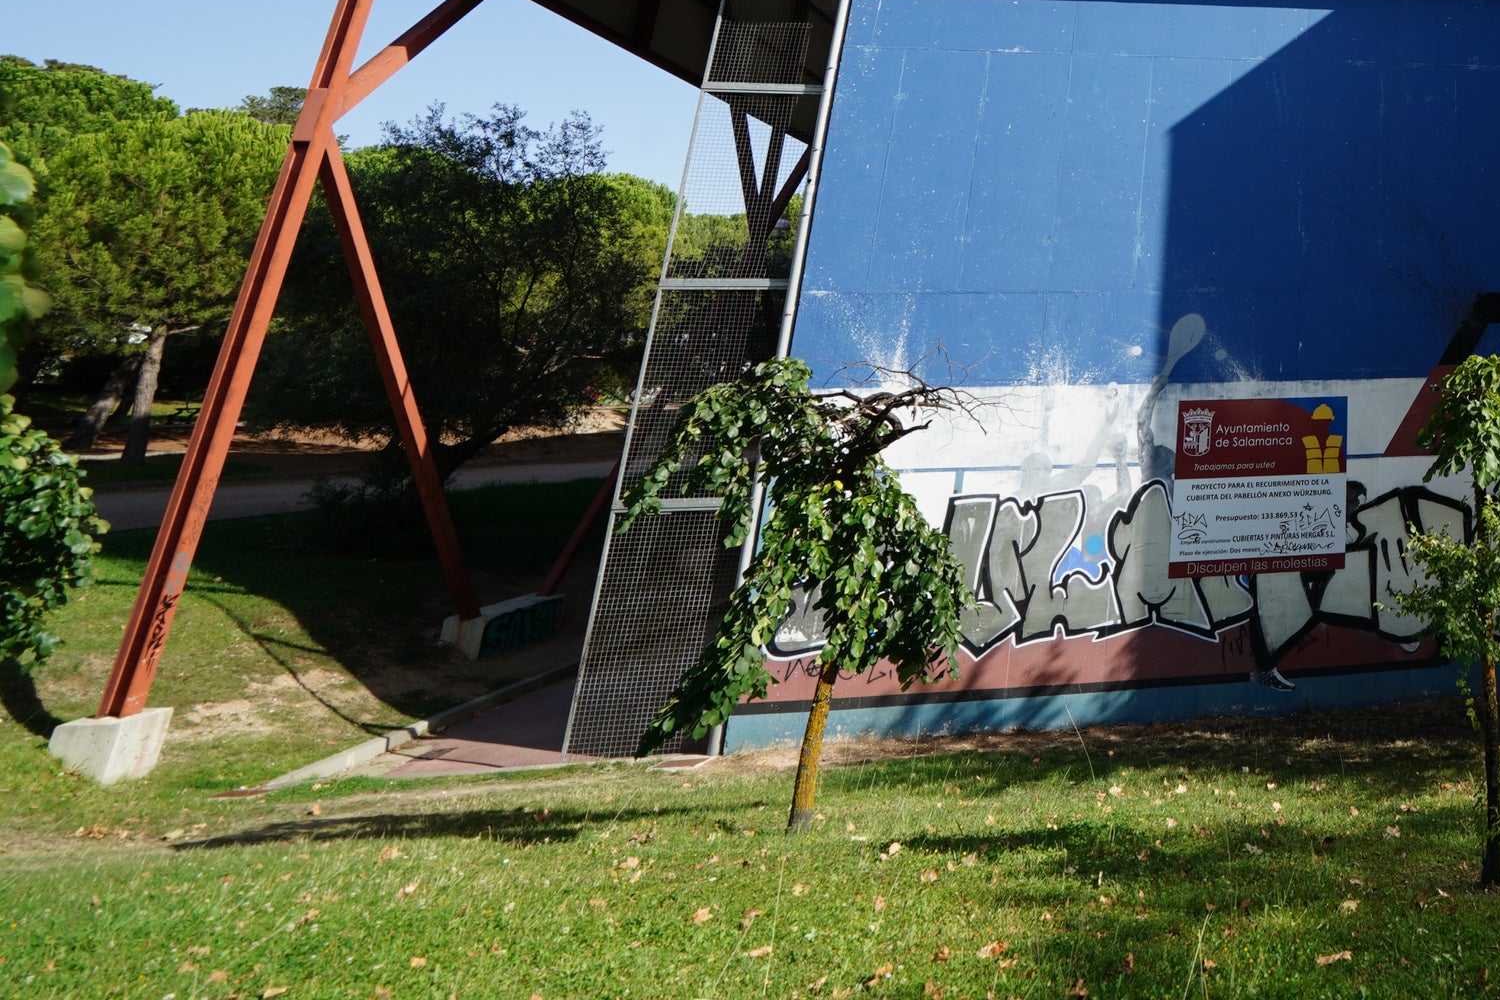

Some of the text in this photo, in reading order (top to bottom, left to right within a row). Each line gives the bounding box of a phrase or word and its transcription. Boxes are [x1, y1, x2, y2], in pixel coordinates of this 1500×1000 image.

[1215, 422, 1290, 435] Ayuntamiento
[1215, 436, 1293, 448] de Salamanca
[1194, 460, 1276, 472] Trabajamos para usted
[1255, 479, 1310, 488] RECUBRIMIENTO
[1234, 491, 1267, 499] PABELLÓN
[1268, 490, 1292, 498] ANEXO
[1215, 513, 1260, 522] Presupuesto:
[1261, 511, 1298, 520] 133.869,53
[1232, 534, 1264, 542] CUBIERTAS
[1270, 532, 1300, 540] PINTURAS
[1300, 531, 1325, 539] HERGAR
[1187, 557, 1328, 575] Disculpen las molestias
